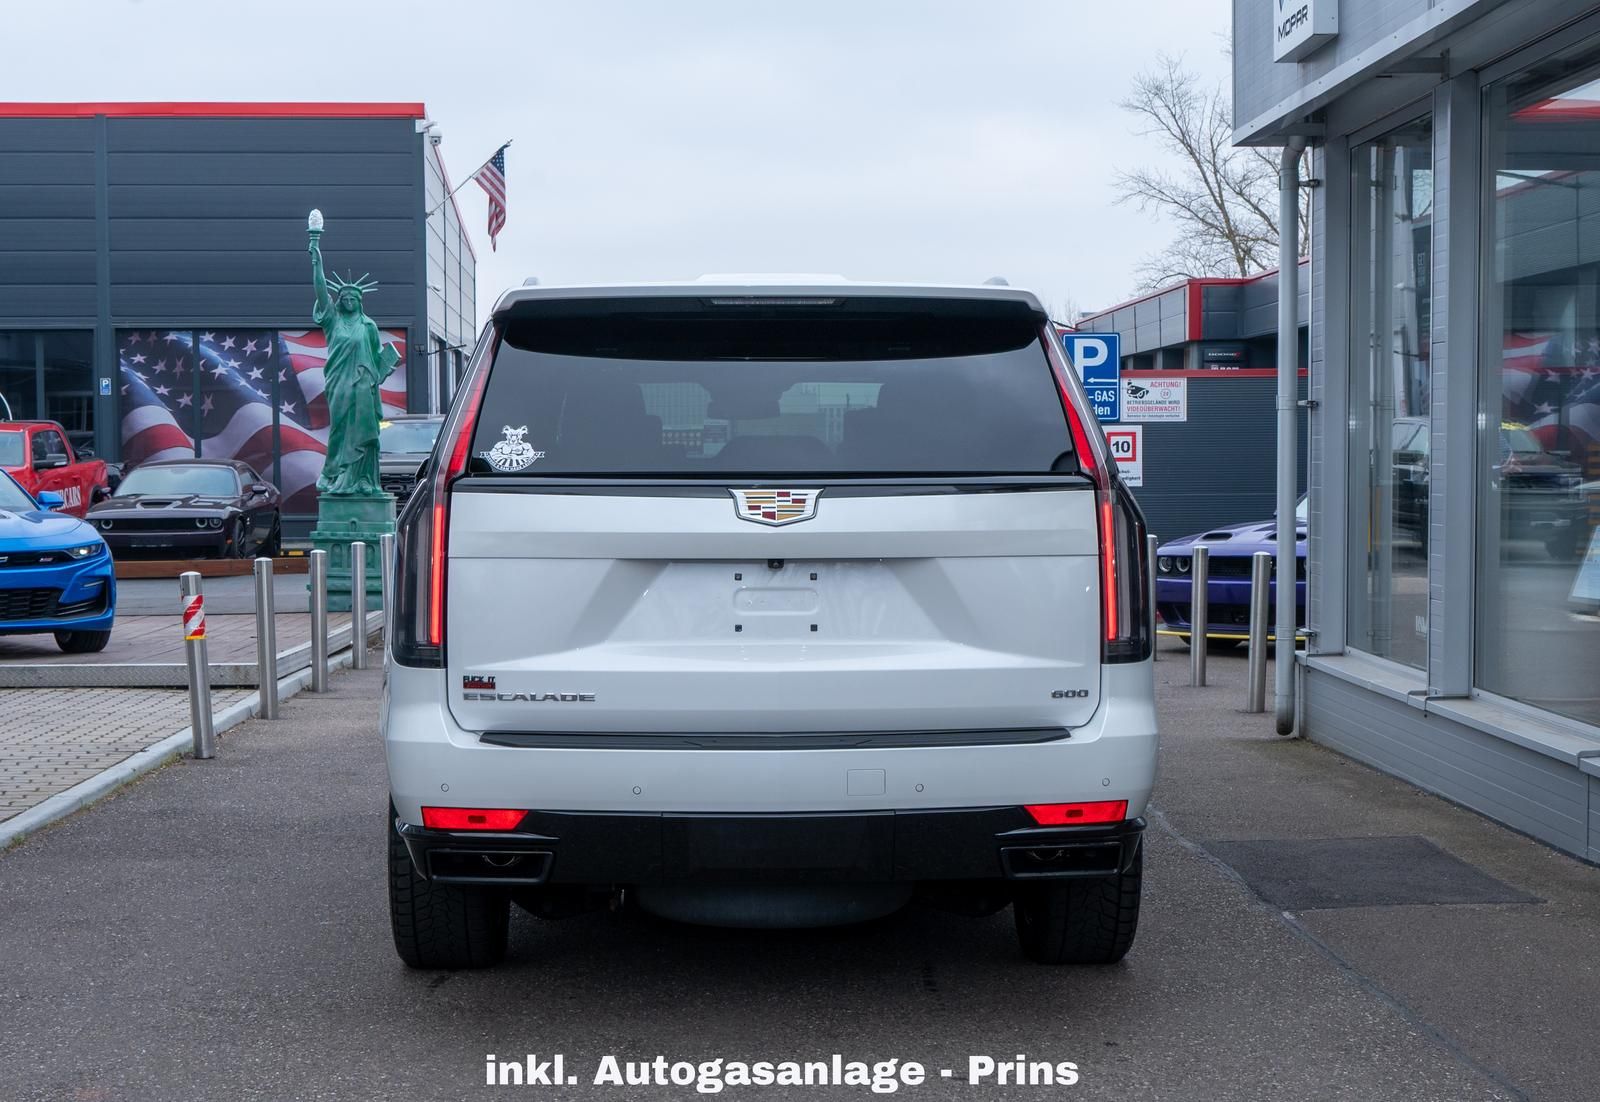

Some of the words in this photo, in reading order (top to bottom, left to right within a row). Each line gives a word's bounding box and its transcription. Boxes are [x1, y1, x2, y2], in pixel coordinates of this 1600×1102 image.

[1278, 4, 1309, 42] MOPAR
[1074, 338, 1109, 383] P
[1112, 440, 1131, 453] 10
[463, 692, 596, 702] ESCALADE
[1051, 689, 1089, 699] 600
